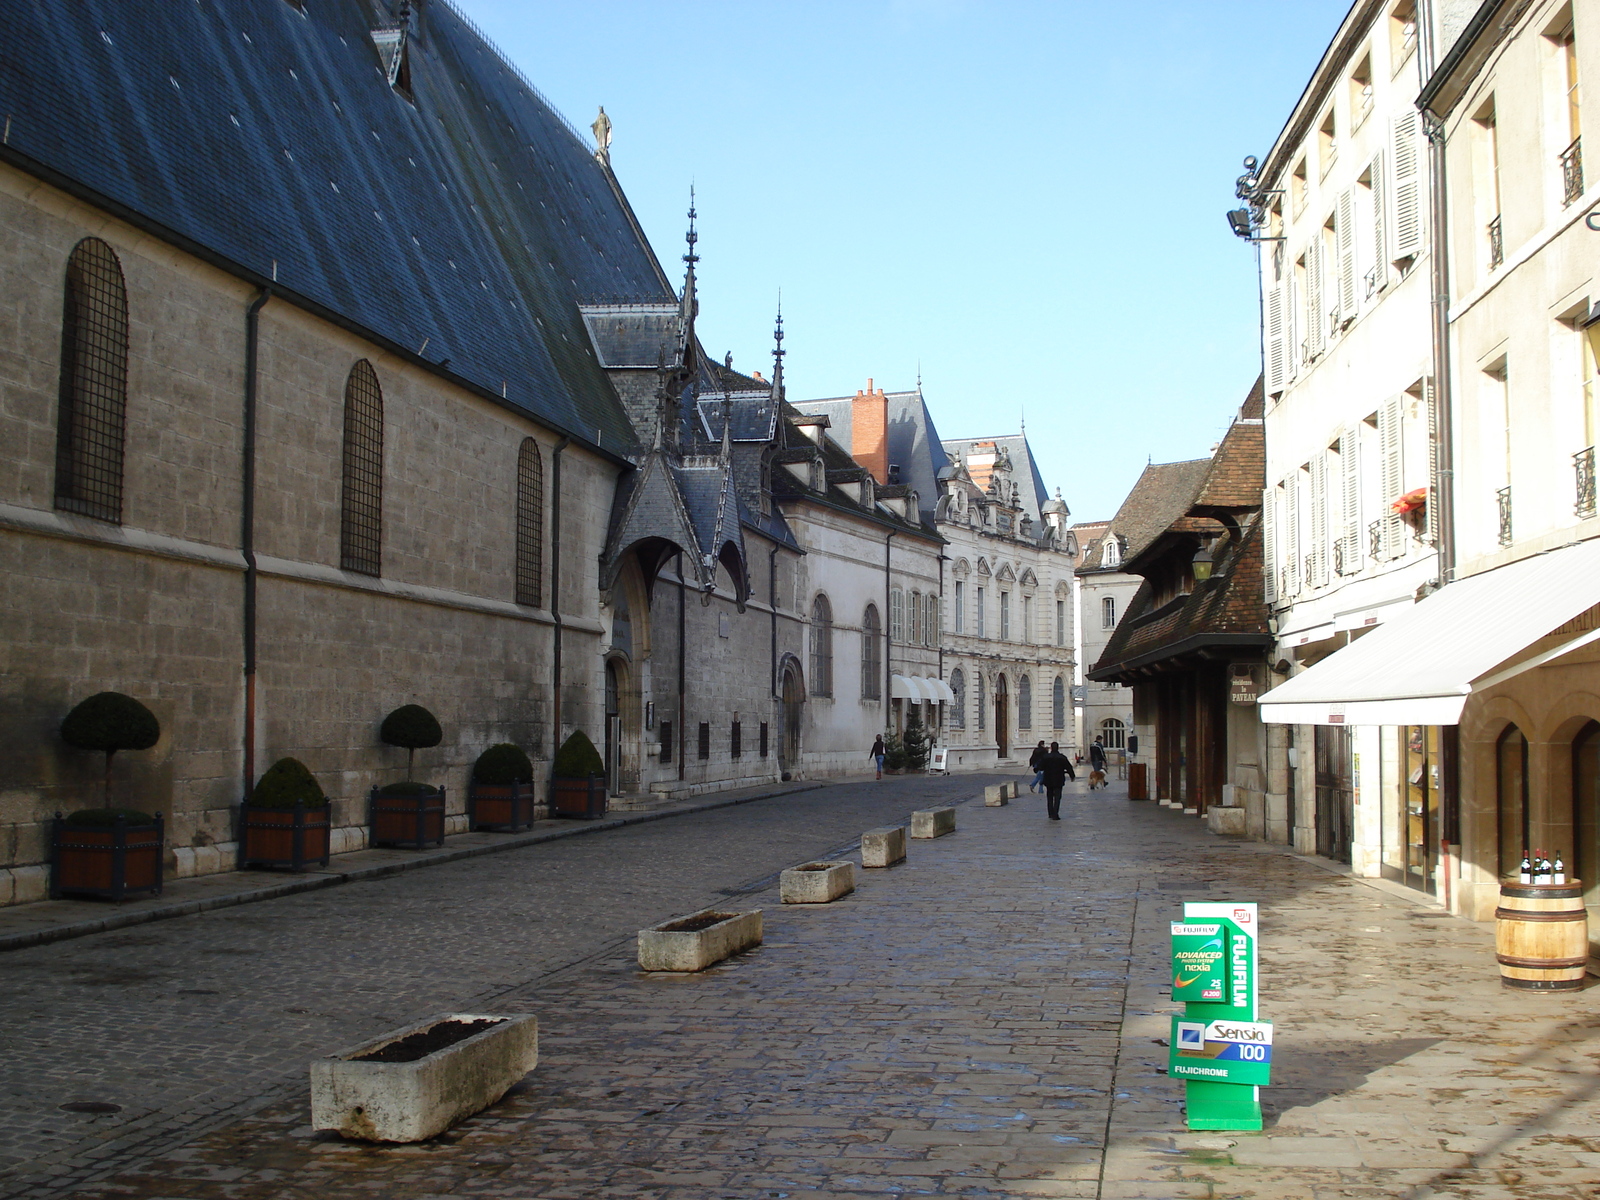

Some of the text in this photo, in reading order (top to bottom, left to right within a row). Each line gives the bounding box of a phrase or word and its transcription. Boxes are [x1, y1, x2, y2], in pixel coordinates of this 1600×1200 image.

[1185, 963, 1211, 972] nexia
[1233, 935, 1247, 1007] FUJIFILM
[1210, 979, 1222, 987] 25
[1214, 1025, 1265, 1041] Sensia
[1238, 1044, 1265, 1061] 100
[1174, 1065, 1228, 1077] FUJICHROME
